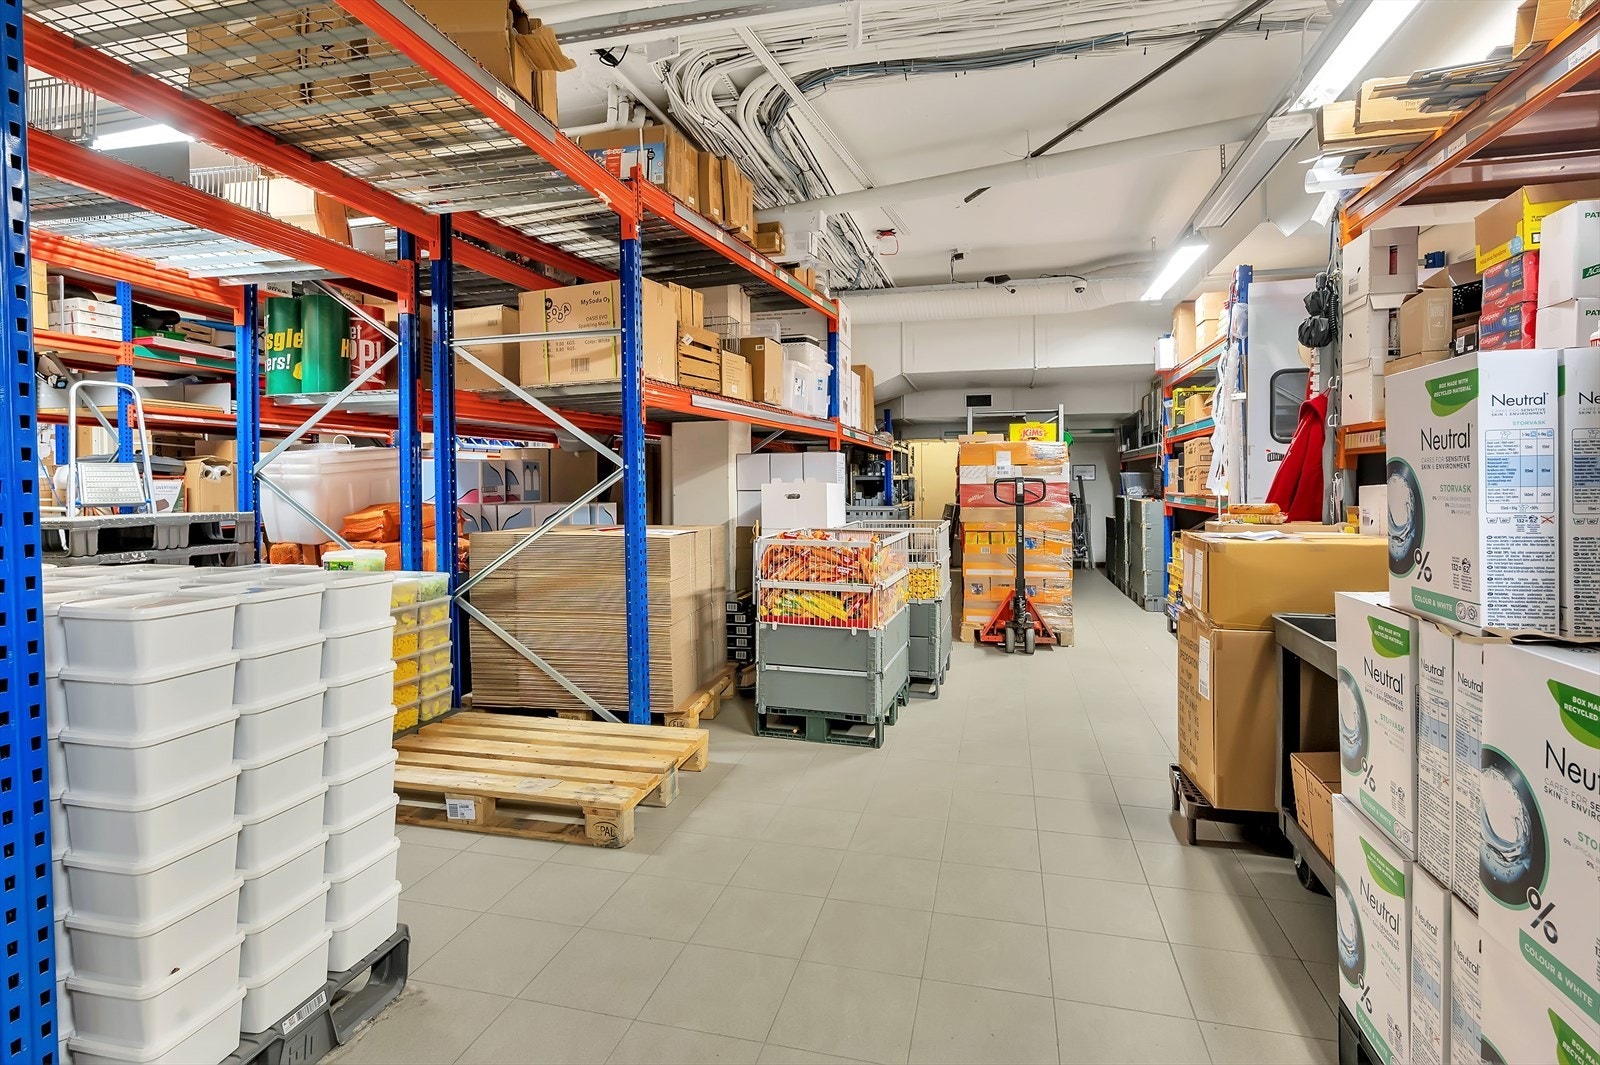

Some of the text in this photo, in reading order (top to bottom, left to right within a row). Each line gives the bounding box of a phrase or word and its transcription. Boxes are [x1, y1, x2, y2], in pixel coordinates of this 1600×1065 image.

[580, 298, 602, 306] MySoda
[1484, 287, 1502, 298] Colgate
[1480, 312, 1500, 321] Colgate
[1480, 335, 1500, 345] Colgate
[1491, 392, 1546, 407] Neutral
[1022, 429, 1044, 438] KiMs
[1420, 423, 1471, 451] Neutral
[1436, 462, 1471, 470] ENVIRONMENT
[1440, 484, 1472, 493] STORVASK
[1415, 594, 1431, 605] COLOUR
[1437, 601, 1453, 611] WHITE
[1364, 656, 1404, 695] Neutral
[1420, 657, 1444, 677] Neutral
[1457, 671, 1483, 693] Neutral
[1572, 696, 1586, 707] BOX
[1564, 702, 1599, 721] RECYCLED
[1546, 739, 1600, 796] Neu
[1544, 778, 1568, 796] CARES
[1571, 791, 1588, 805] FOR
[1544, 785, 1561, 800] SKIN
[1578, 831, 1600, 853] STO
[1360, 875, 1399, 935] Neutral
[1414, 905, 1437, 937] Neutral
[1453, 940, 1479, 975] Neutral
[1524, 943, 1556, 975] COLOUR
[1557, 971, 1563, 981] &
[1565, 976, 1594, 1008] WHITE
